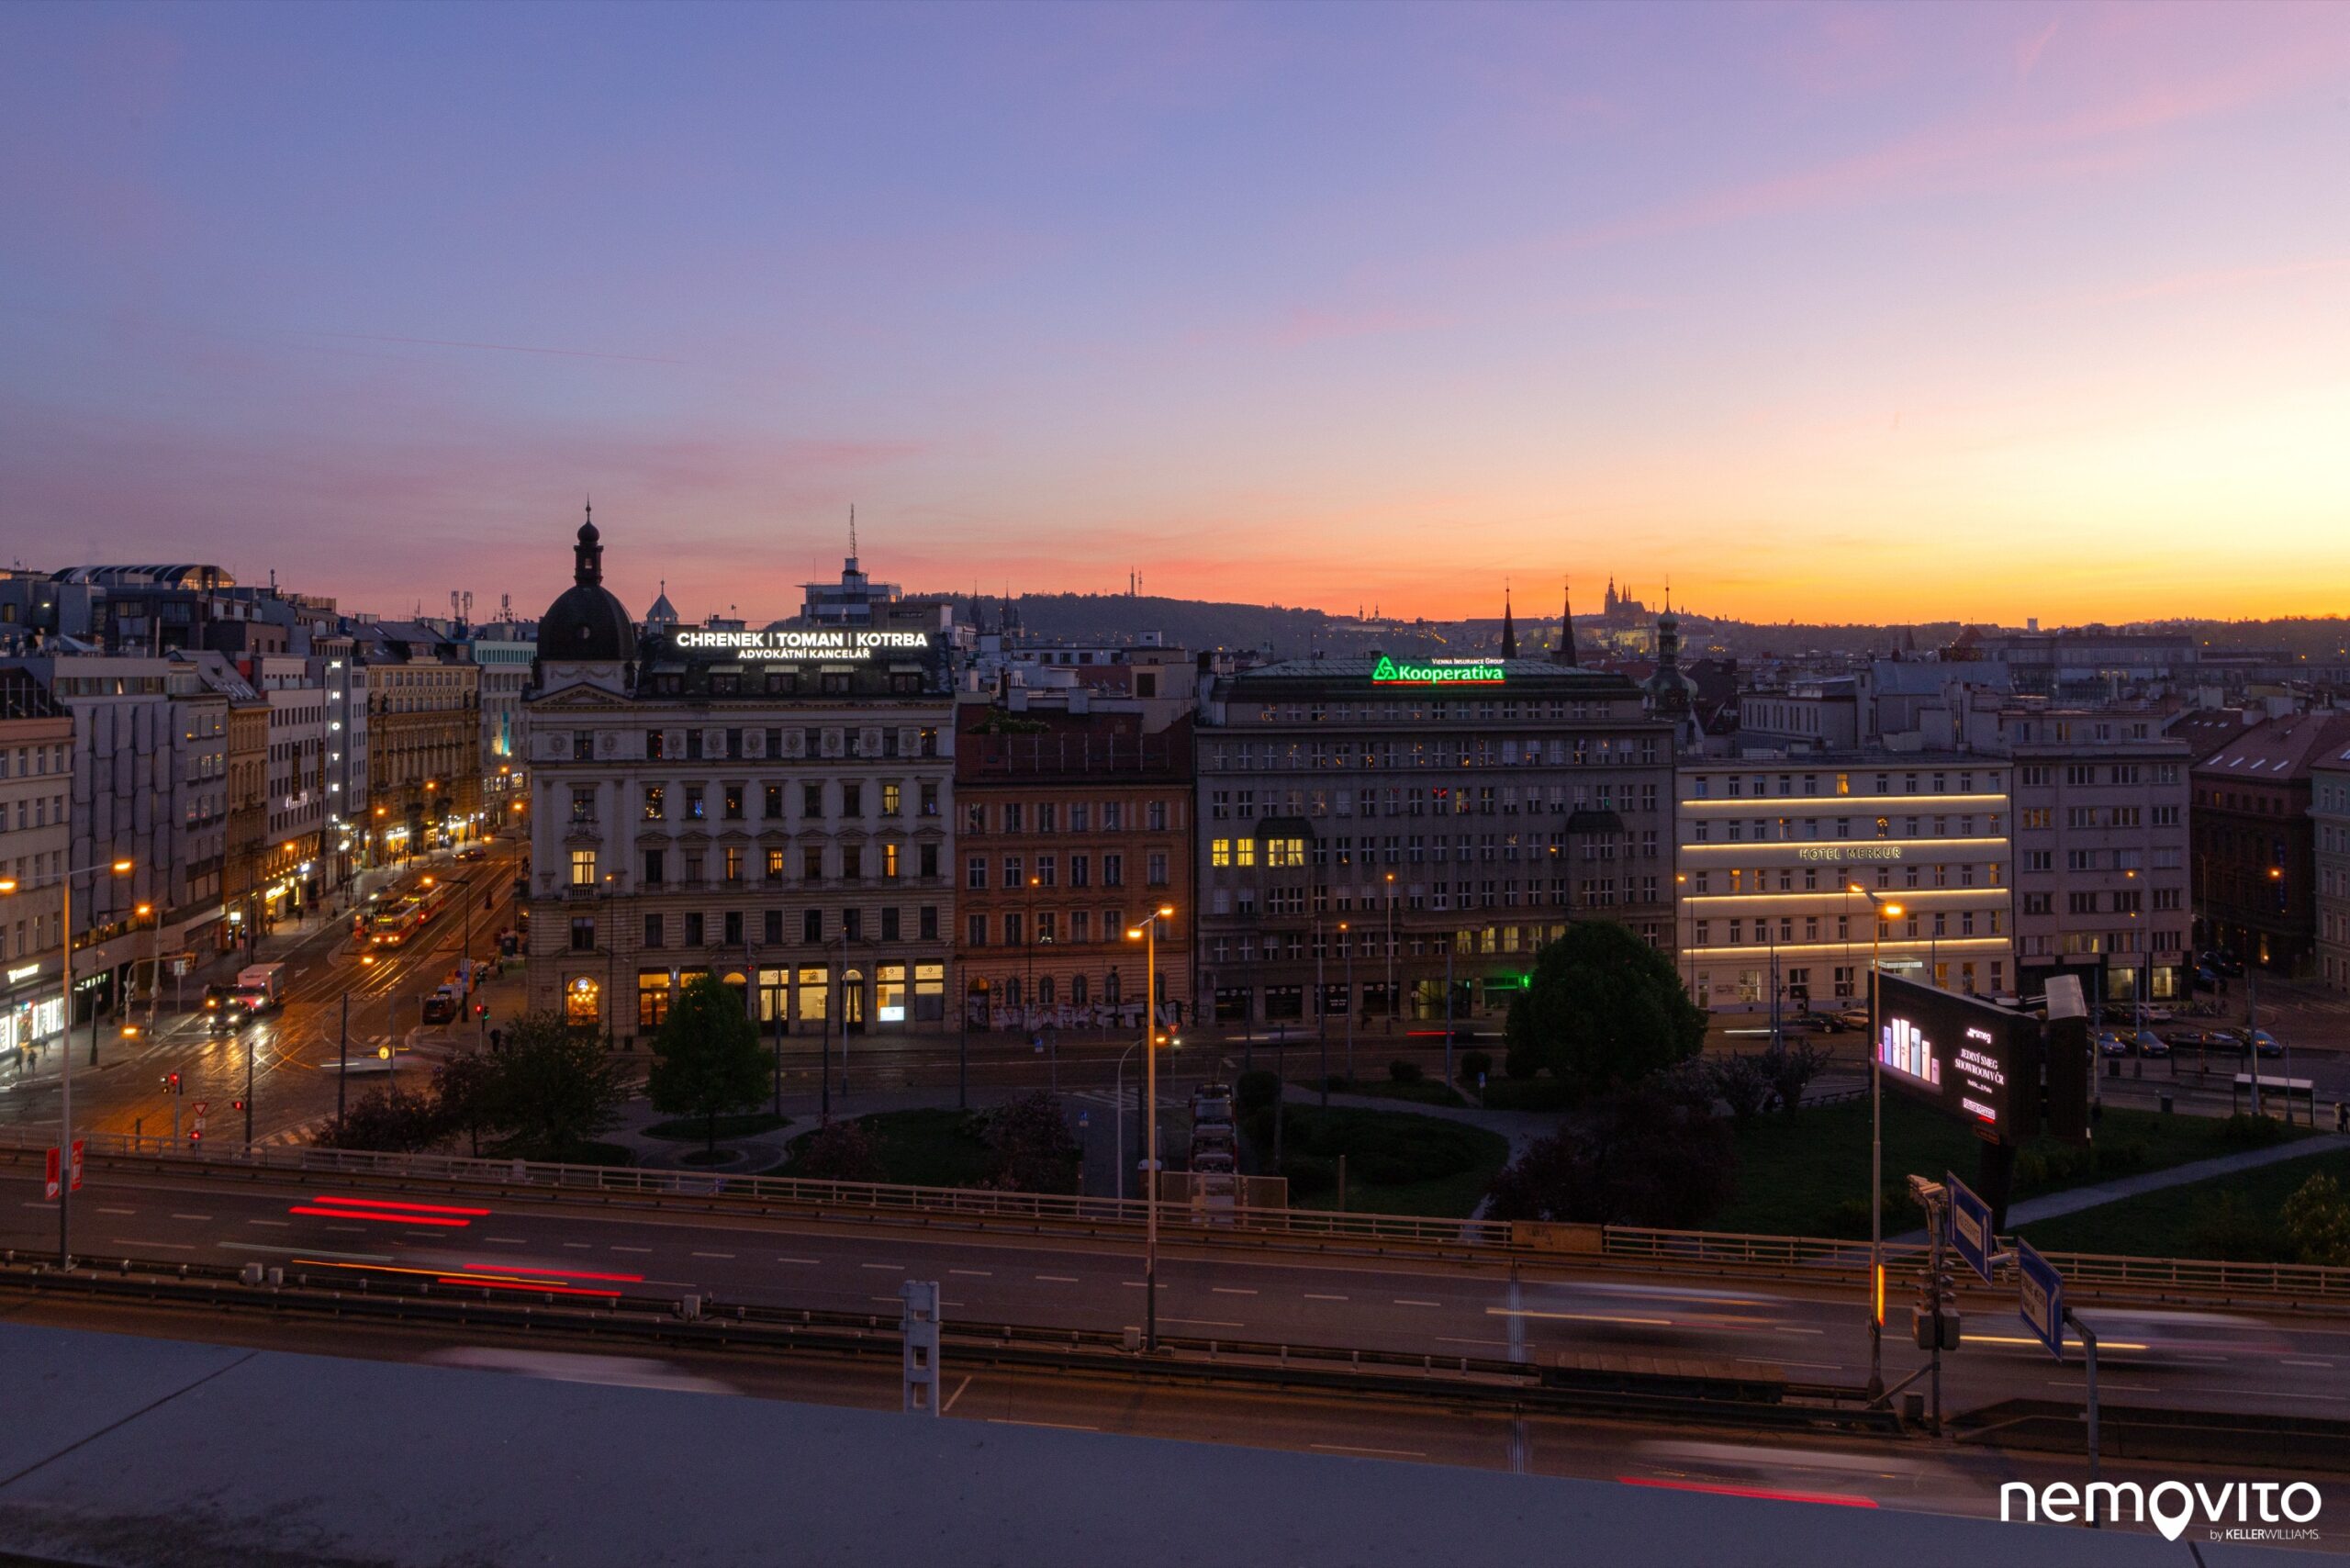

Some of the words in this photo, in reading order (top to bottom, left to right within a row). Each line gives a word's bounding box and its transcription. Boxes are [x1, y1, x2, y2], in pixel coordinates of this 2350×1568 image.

[676, 632, 765, 647] CHRENEK
[777, 632, 844, 647] TOMAN
[856, 632, 928, 647] KOTRBA
[738, 647, 807, 659] ADVOKÁTNÍ
[809, 646, 870, 659] KANCELÁŘ
[1399, 665, 1504, 684] Kooperativa
[331, 691, 341, 823] HOTEL
[1799, 848, 1841, 860] HOTEL
[1847, 846, 1902, 859] MERKUR
[1981, 1056, 1998, 1070] SMEG
